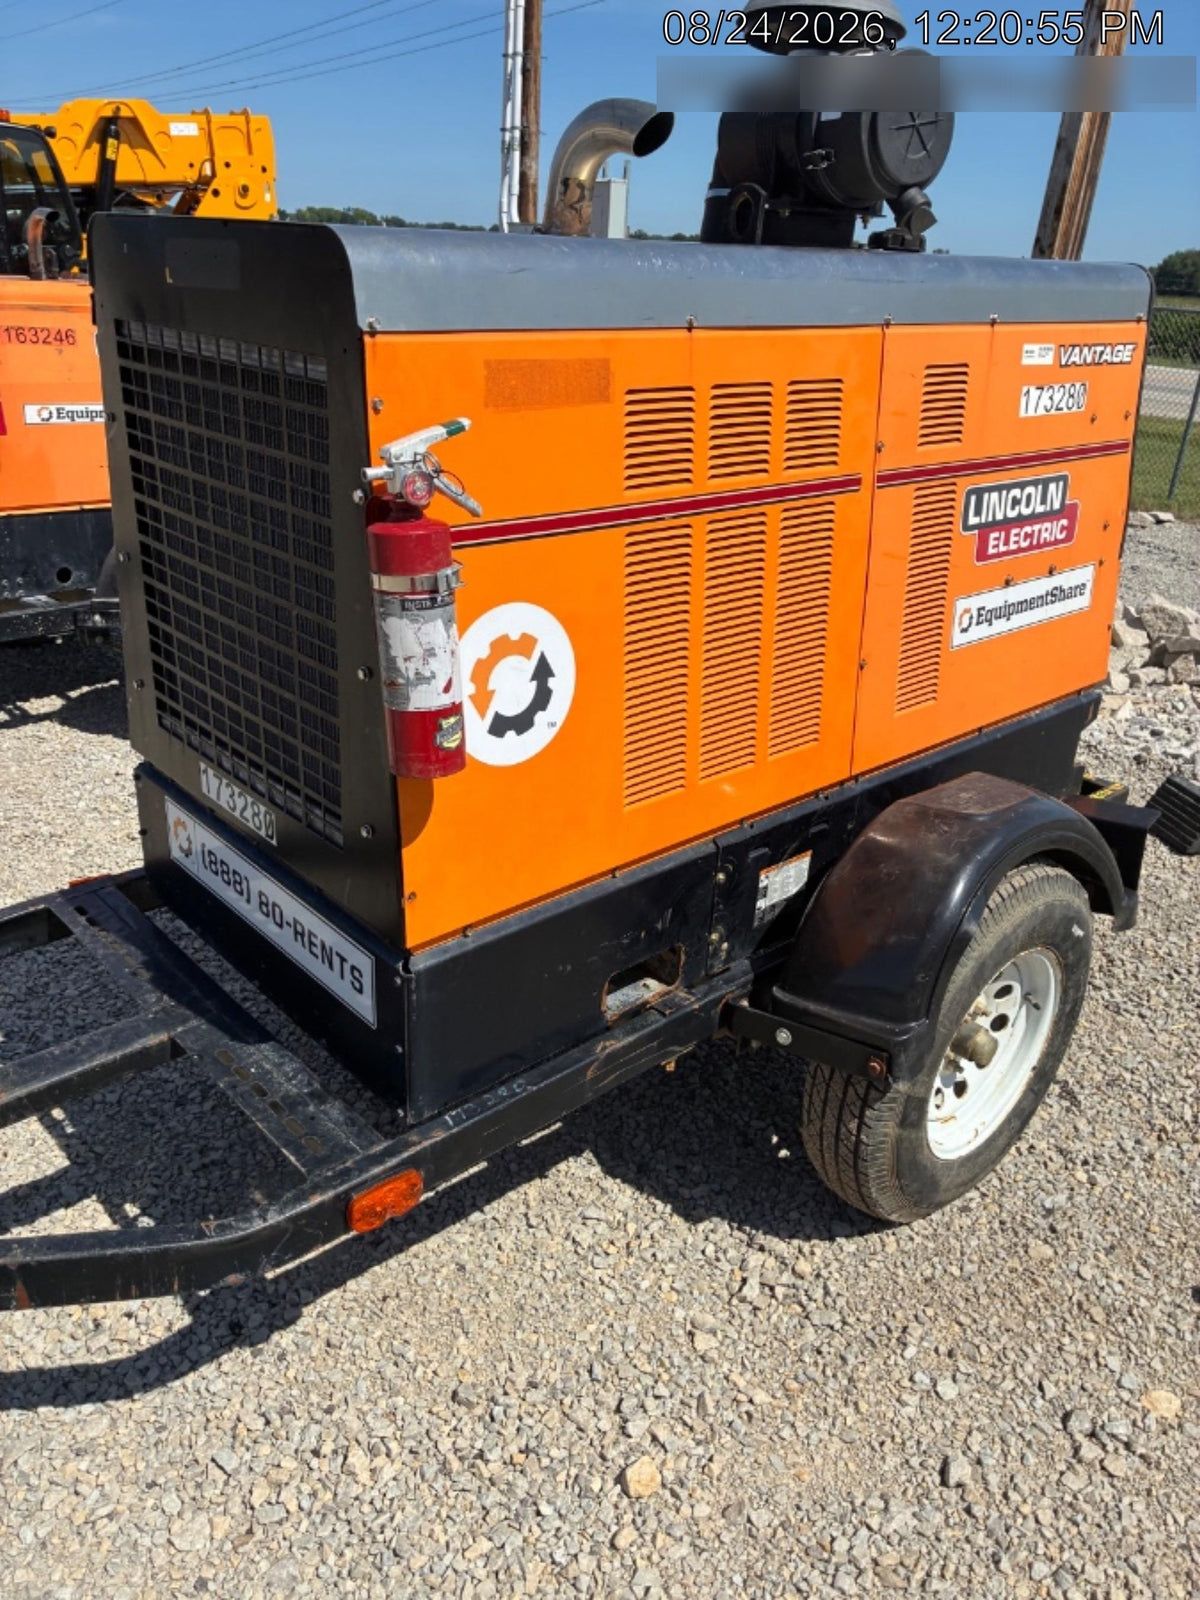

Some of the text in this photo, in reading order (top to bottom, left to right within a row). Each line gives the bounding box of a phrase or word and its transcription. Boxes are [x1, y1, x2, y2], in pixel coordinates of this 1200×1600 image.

[4, 325, 77, 346] 163246
[1059, 343, 1137, 367] VANTAGE
[1022, 382, 1087, 415] 173280
[967, 480, 1065, 526] LINCOLN
[986, 518, 1069, 555] ELECTRIC
[974, 582, 1088, 627] EquipmentShare
[201, 768, 276, 841] 173280
[201, 842, 364, 995] (888) 80-RENTS
